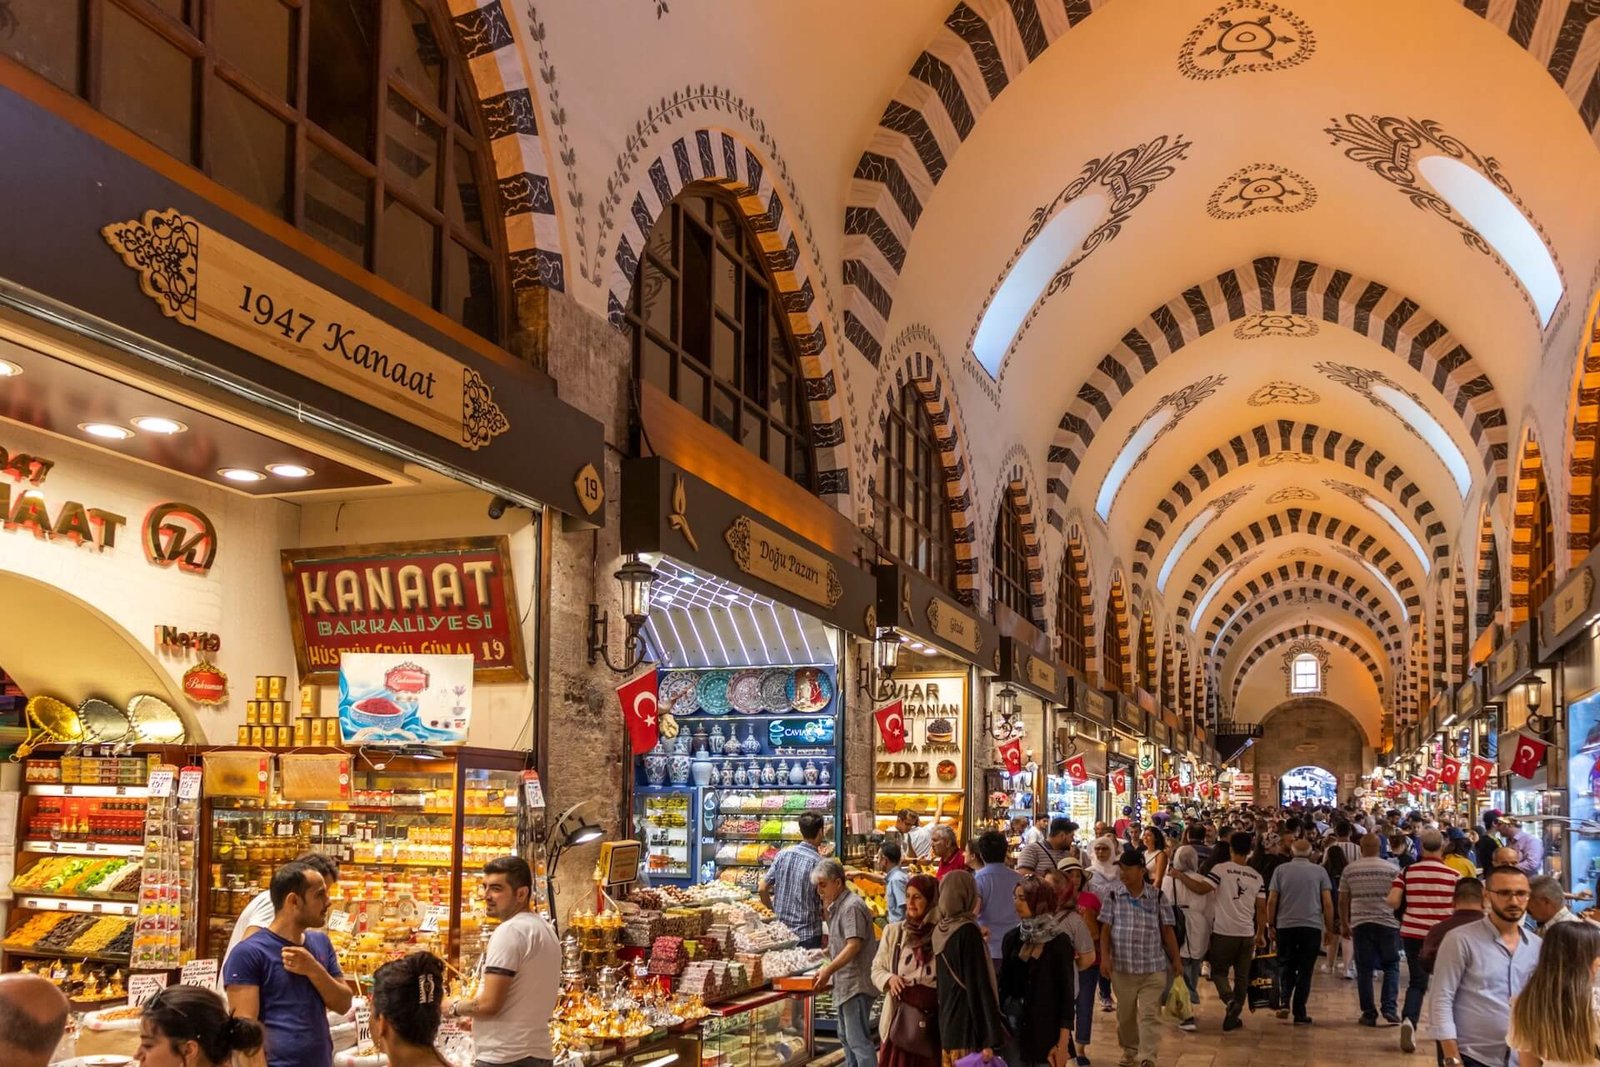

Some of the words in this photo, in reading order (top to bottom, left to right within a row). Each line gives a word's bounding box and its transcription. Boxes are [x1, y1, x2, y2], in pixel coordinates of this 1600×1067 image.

[239, 285, 316, 343] 1947
[322, 322, 437, 400] Kanaat
[584, 476, 598, 500] 19
[759, 541, 786, 571] Doğu
[788, 553, 820, 585] Pazarı
[300, 560, 494, 614] KANAAT
[317, 612, 493, 637] BAKKALİYESİ
[481, 638, 505, 661] 19
[903, 703, 958, 715] IRANIAN
